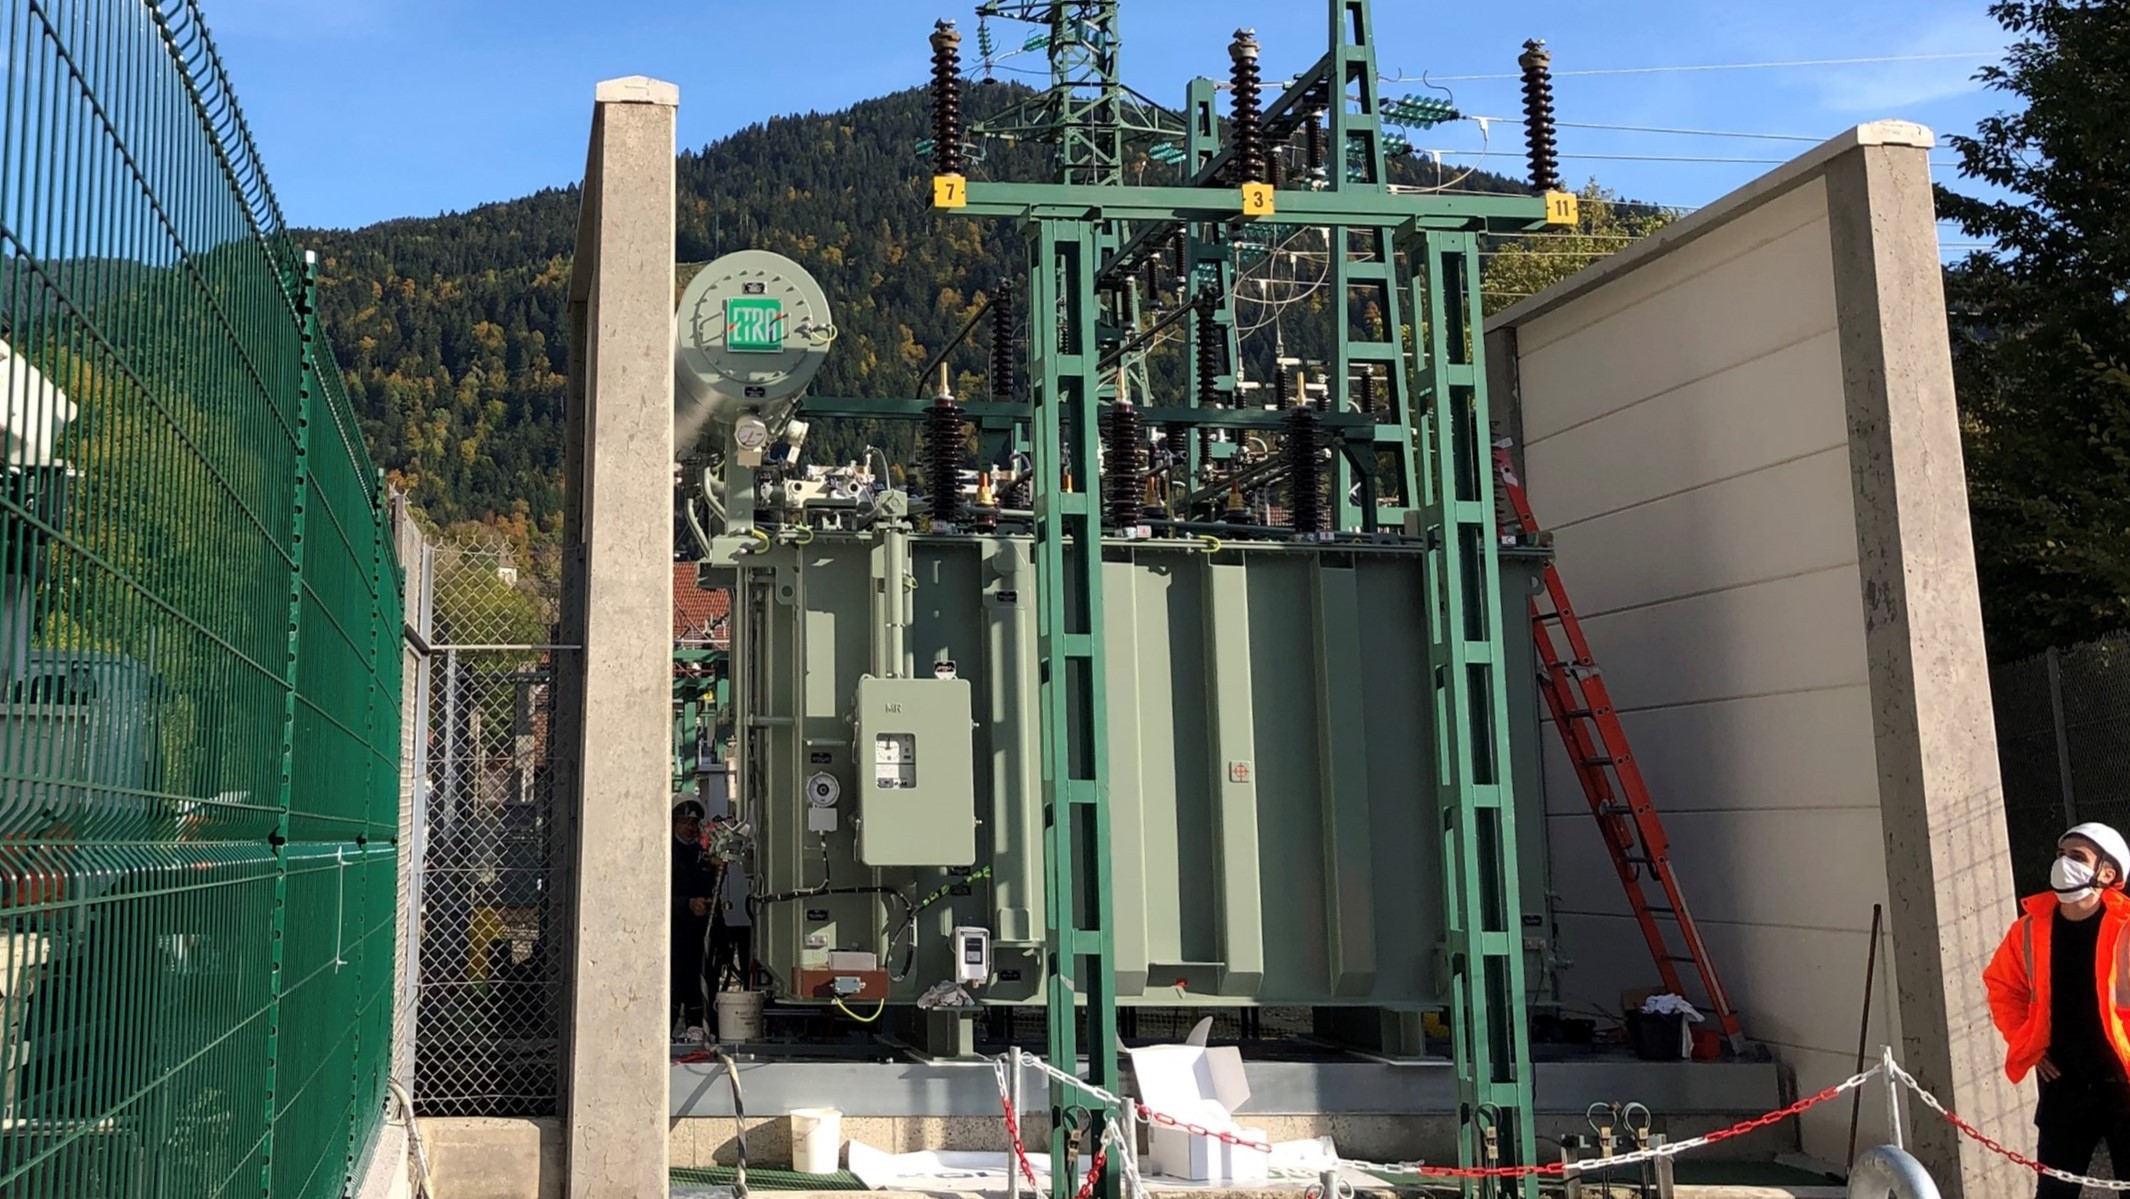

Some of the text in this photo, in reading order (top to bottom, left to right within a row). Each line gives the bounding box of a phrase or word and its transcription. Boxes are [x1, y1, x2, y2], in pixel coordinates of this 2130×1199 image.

[945, 183, 955, 200] 7
[1253, 191, 1264, 208] 3
[1555, 199, 1569, 216] 11
[733, 307, 777, 342] ETRA
[885, 703, 902, 713] MR
